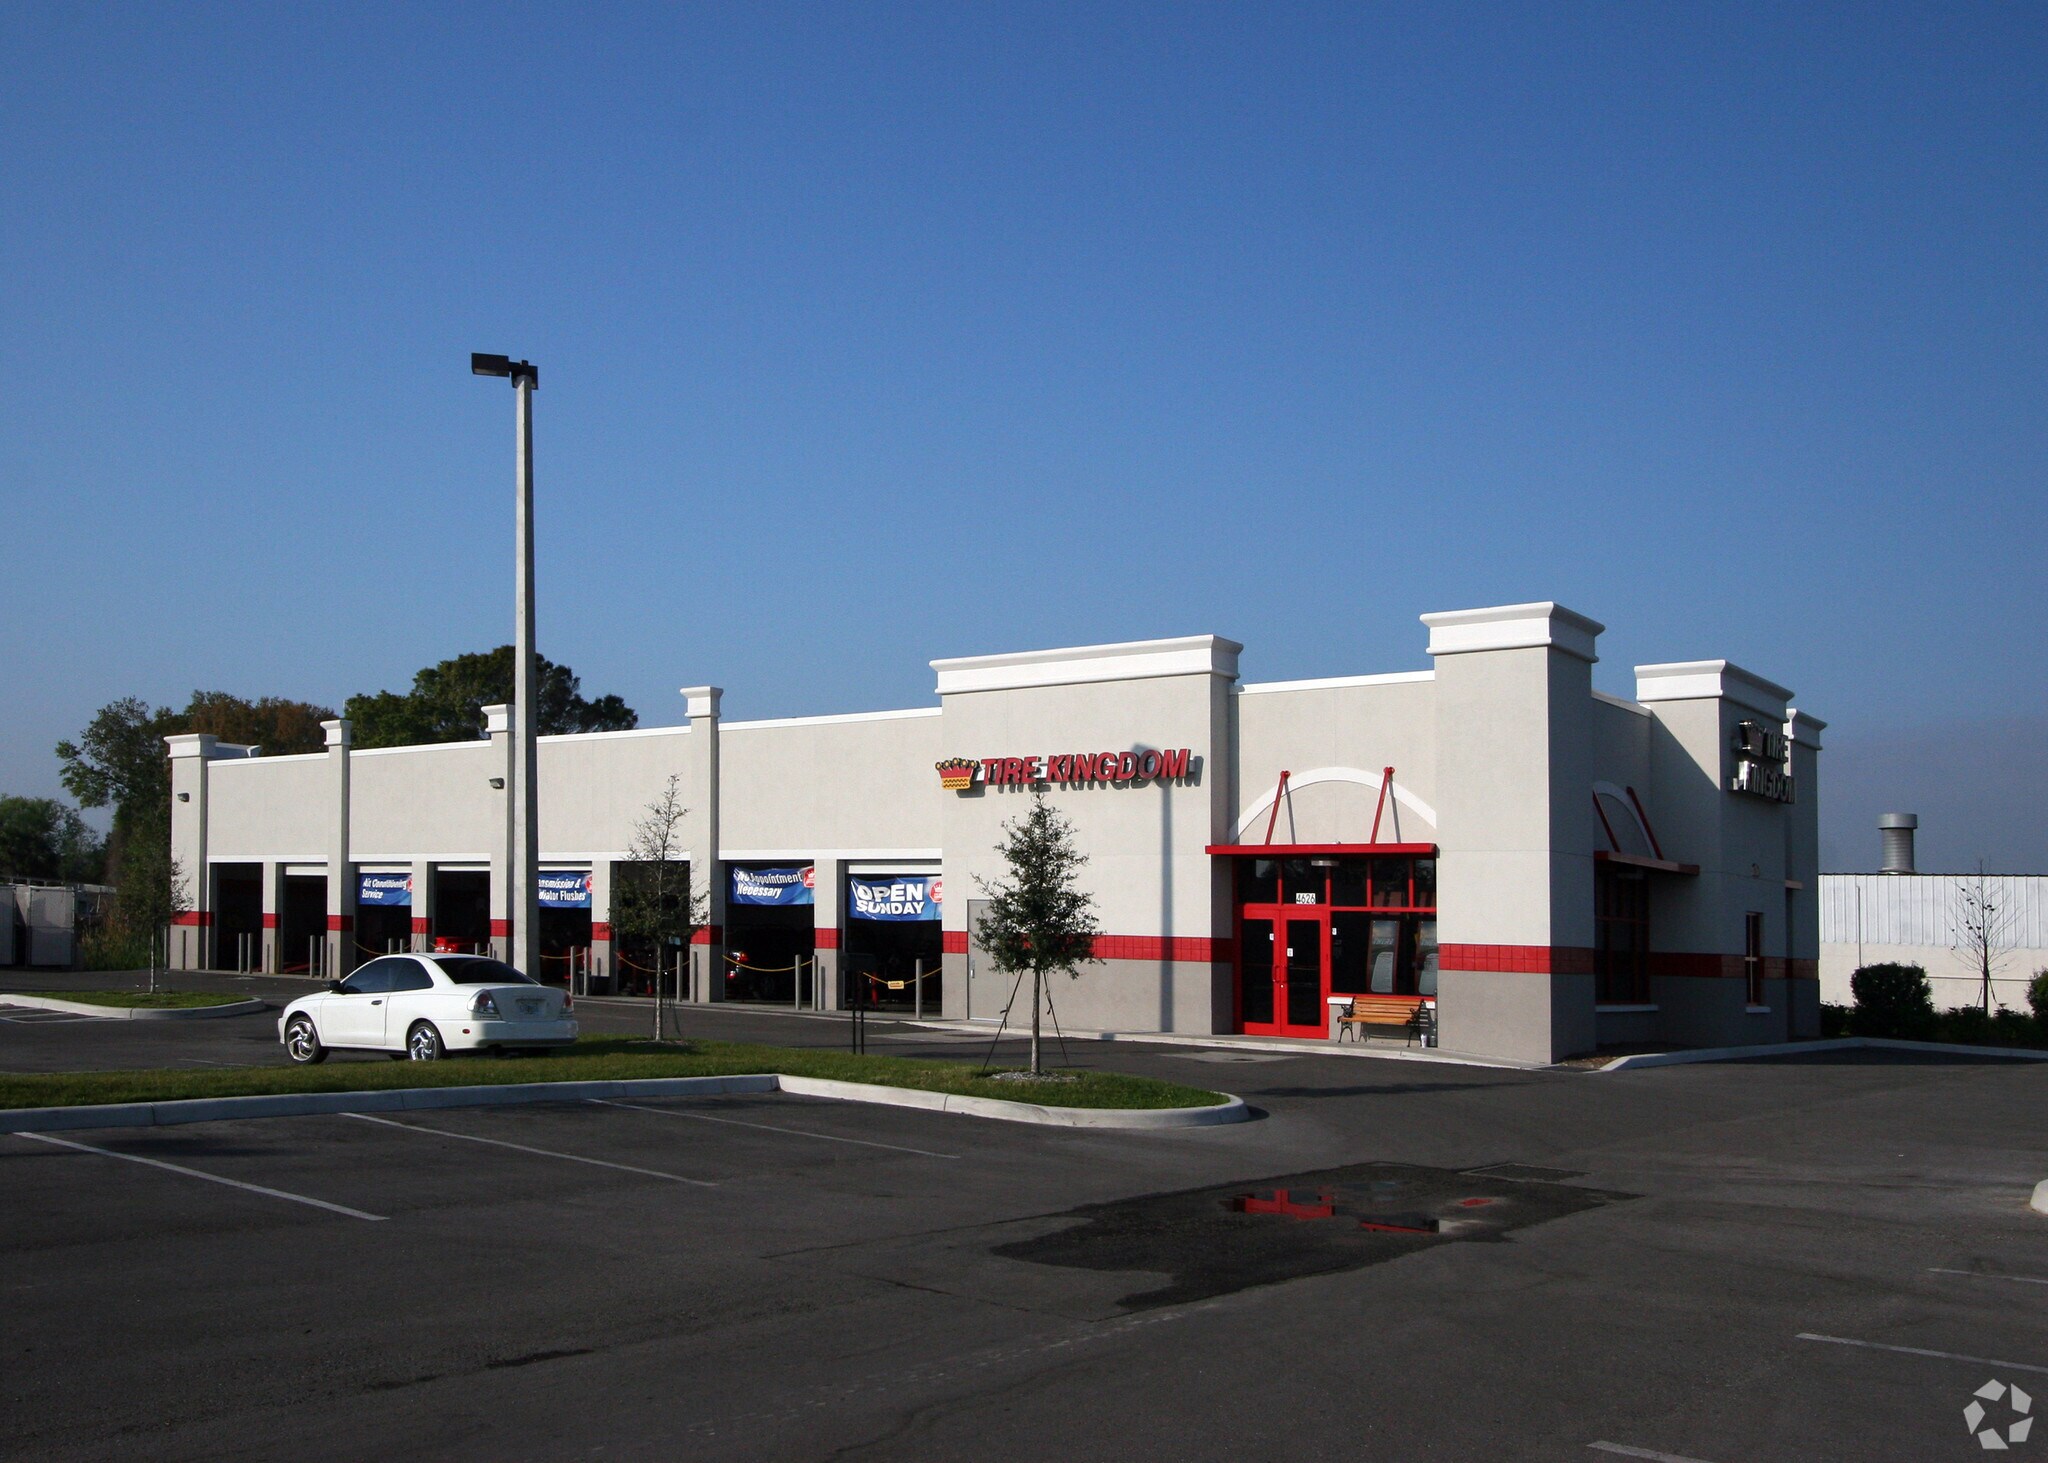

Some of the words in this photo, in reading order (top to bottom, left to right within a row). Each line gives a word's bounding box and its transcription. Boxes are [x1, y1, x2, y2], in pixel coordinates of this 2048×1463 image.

[981, 756, 1041, 785] TIRE
[1046, 748, 1192, 782] KINGDOM
[363, 878, 371, 887] Air
[575, 879, 581, 888] &
[750, 871, 804, 885] Appointment
[362, 888, 383, 898] Service
[560, 890, 586, 901] Flushes
[737, 882, 782, 899] Necessary
[857, 884, 923, 902] OPEN
[1296, 893, 1316, 904] 4626
[856, 899, 925, 915] SUNDAY
